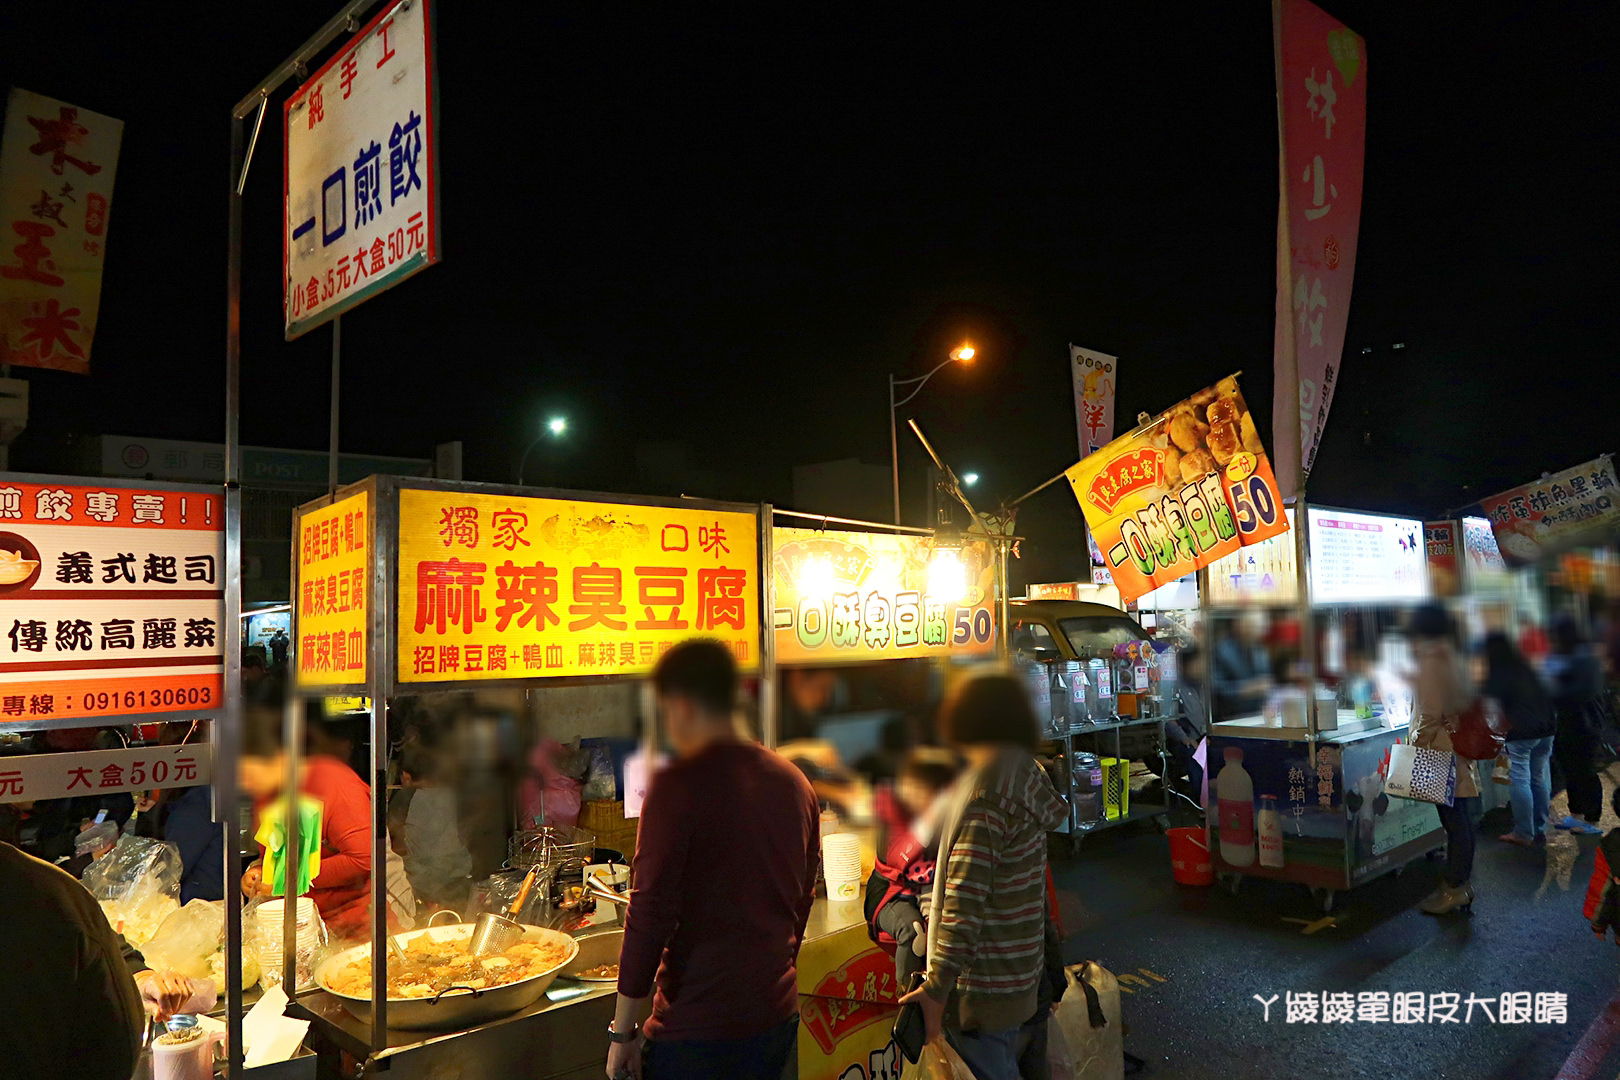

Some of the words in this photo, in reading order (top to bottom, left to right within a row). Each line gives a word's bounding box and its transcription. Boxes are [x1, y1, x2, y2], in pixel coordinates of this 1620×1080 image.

[308, 18, 396, 130] 純手工
[293, 110, 422, 248] 一口煎餃
[256, 462, 303, 479] POST
[1230, 475, 1277, 534] 50
[1490, 468, 1614, 523] 炸蛋旗魚黑輪
[439, 506, 532, 552] 獨家
[660, 521, 730, 559] 口味
[55, 551, 216, 585] 義式起司
[1229, 573, 1275, 589] TEA
[1247, 556, 1256, 565] &
[302, 567, 364, 618] 麻辣臭豆腐
[413, 557, 747, 635] 麻辣臭豆腐
[8, 617, 217, 654] 傳統高麗菜
[953, 607, 993, 645] 50
[301, 627, 363, 674] 麻辣鴨血
[0, 771, 25, 797] 元
[66, 757, 198, 791] 大盒50元
